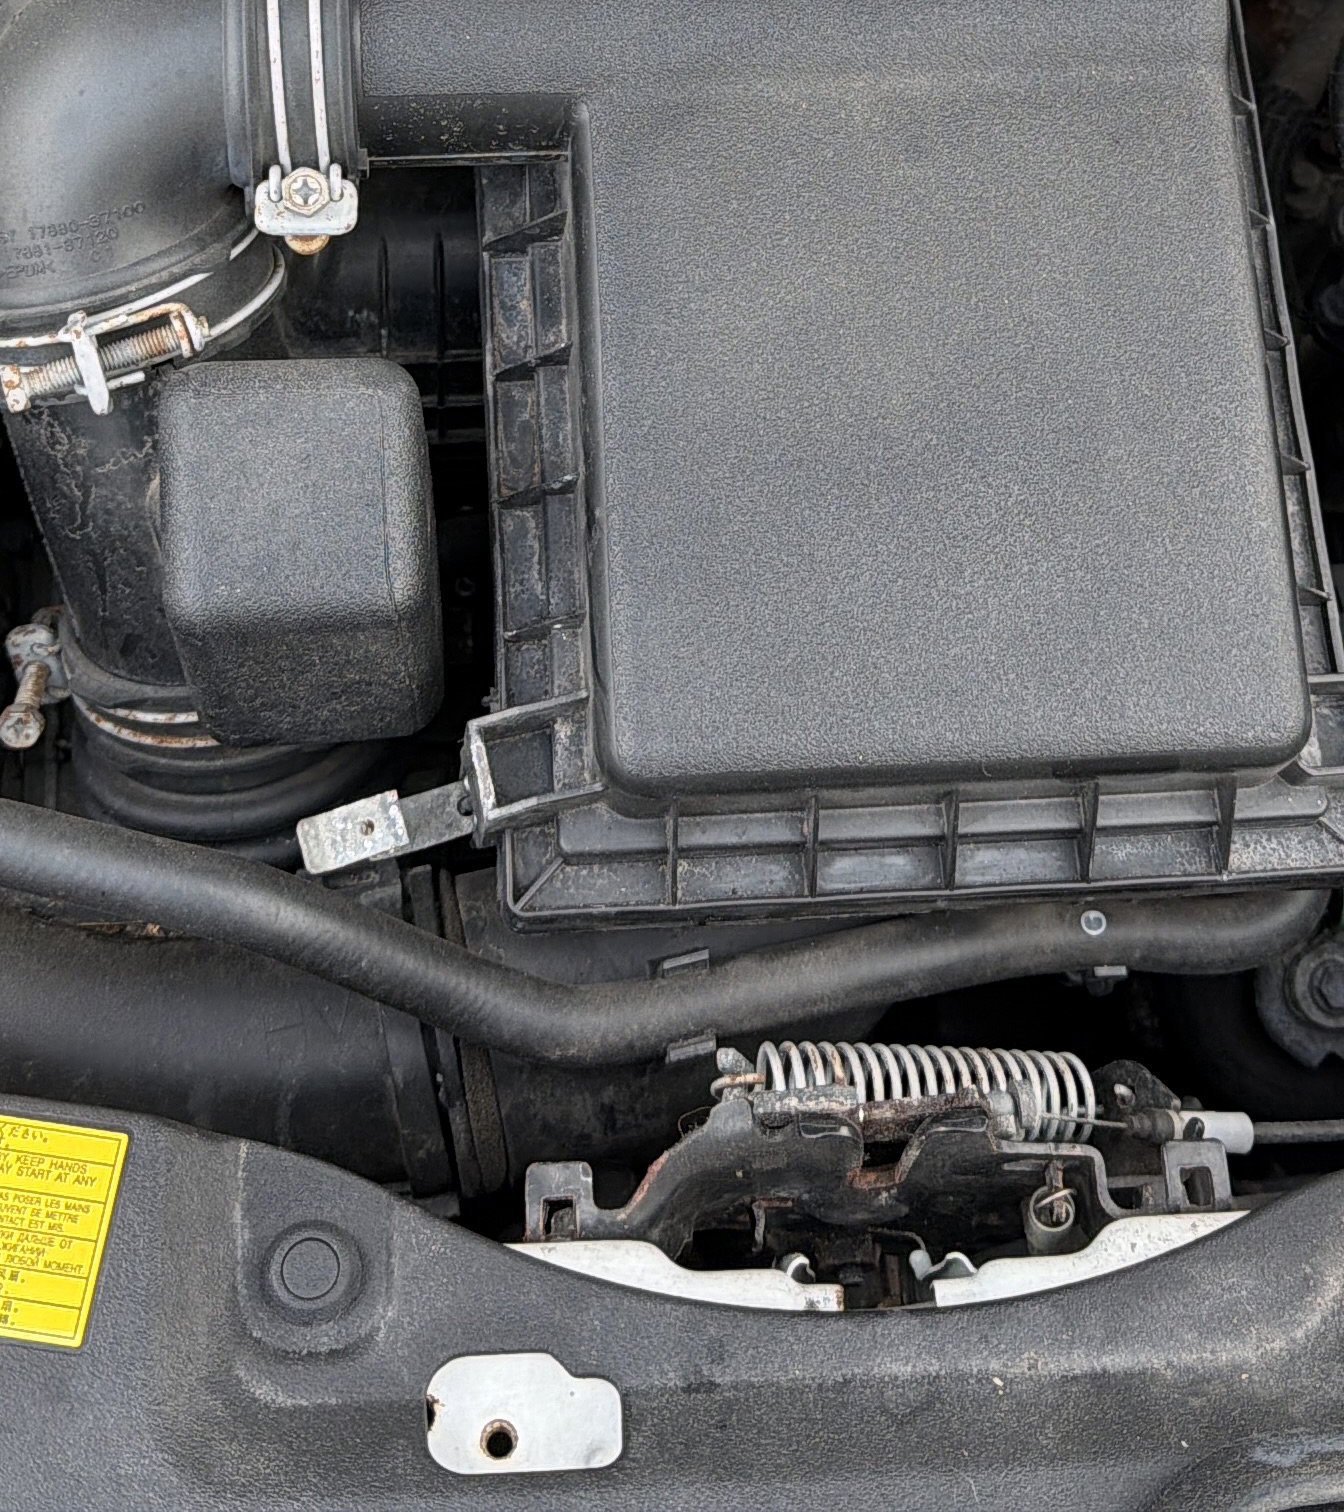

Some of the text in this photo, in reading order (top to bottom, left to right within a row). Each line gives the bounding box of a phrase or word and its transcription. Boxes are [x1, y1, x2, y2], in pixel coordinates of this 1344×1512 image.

[15, 1153, 45, 1167] KEEP
[49, 1159, 88, 1174] HANDS
[16, 1165, 52, 1180] START
[54, 1171, 69, 1183] AT
[72, 1174, 97, 1187] ANY
